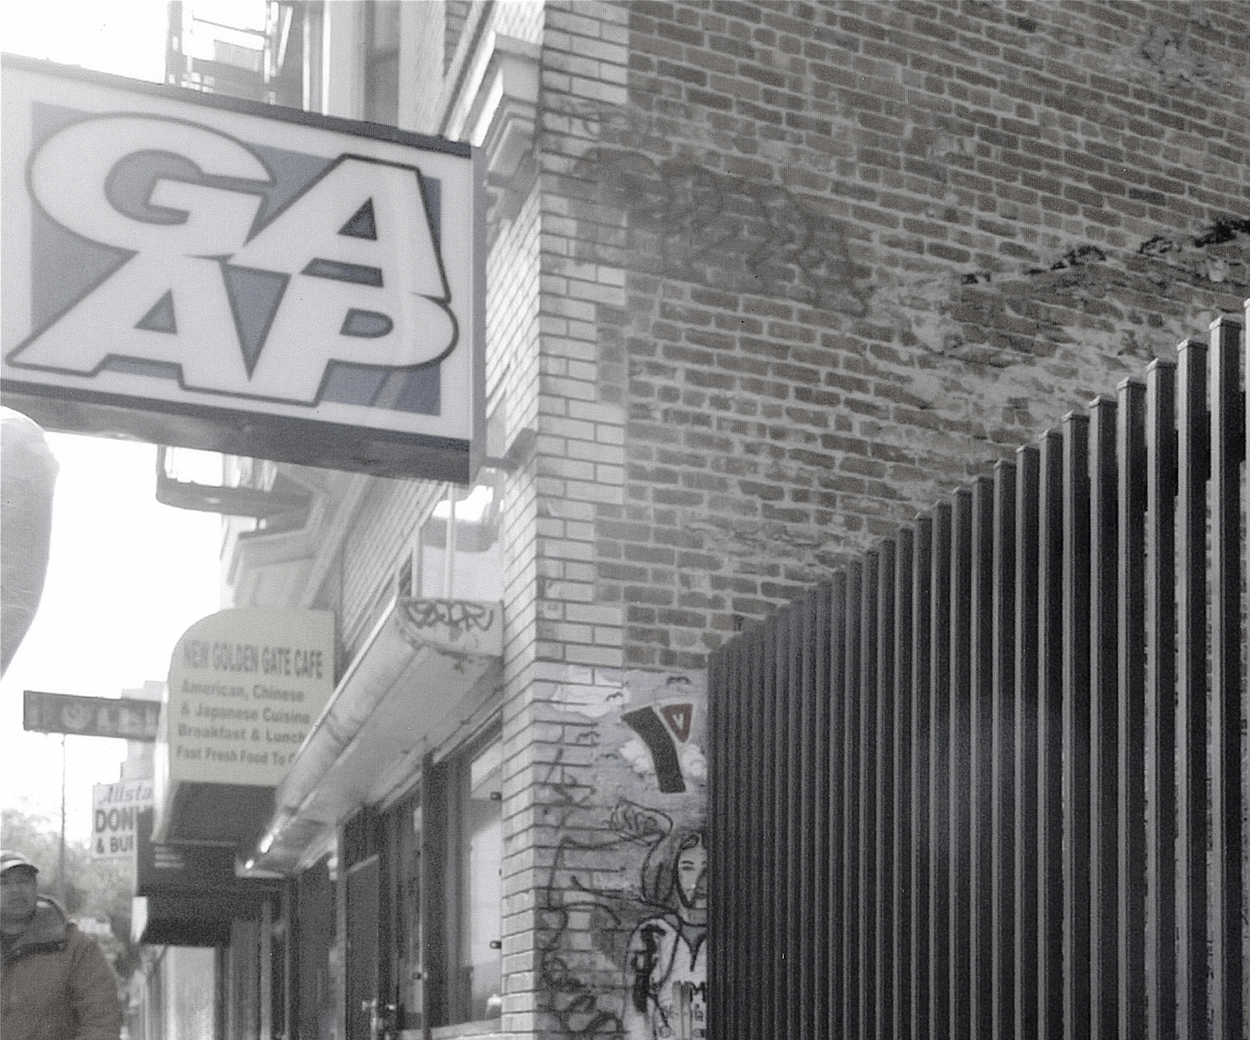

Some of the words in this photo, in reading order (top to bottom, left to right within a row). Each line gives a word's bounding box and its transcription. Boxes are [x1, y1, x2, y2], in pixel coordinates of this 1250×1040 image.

[183, 640, 209, 669] NEW
[212, 642, 259, 673] GOLDEN
[262, 646, 292, 676] GATE
[294, 649, 324, 679] CAFE
[181, 679, 249, 701] American,
[252, 684, 305, 703] Chinese
[180, 701, 190, 717] &
[195, 703, 258, 722] Japanese
[262, 707, 311, 725] Cuisine
[177, 722, 246, 740] Breakfast
[250, 728, 260, 743] &
[176, 744, 202, 761] Fast
[204, 746, 238, 763] Fresh
[240, 749, 269, 765] Food
[272, 751, 287, 766] To
[99, 785, 153, 804] Allsta
